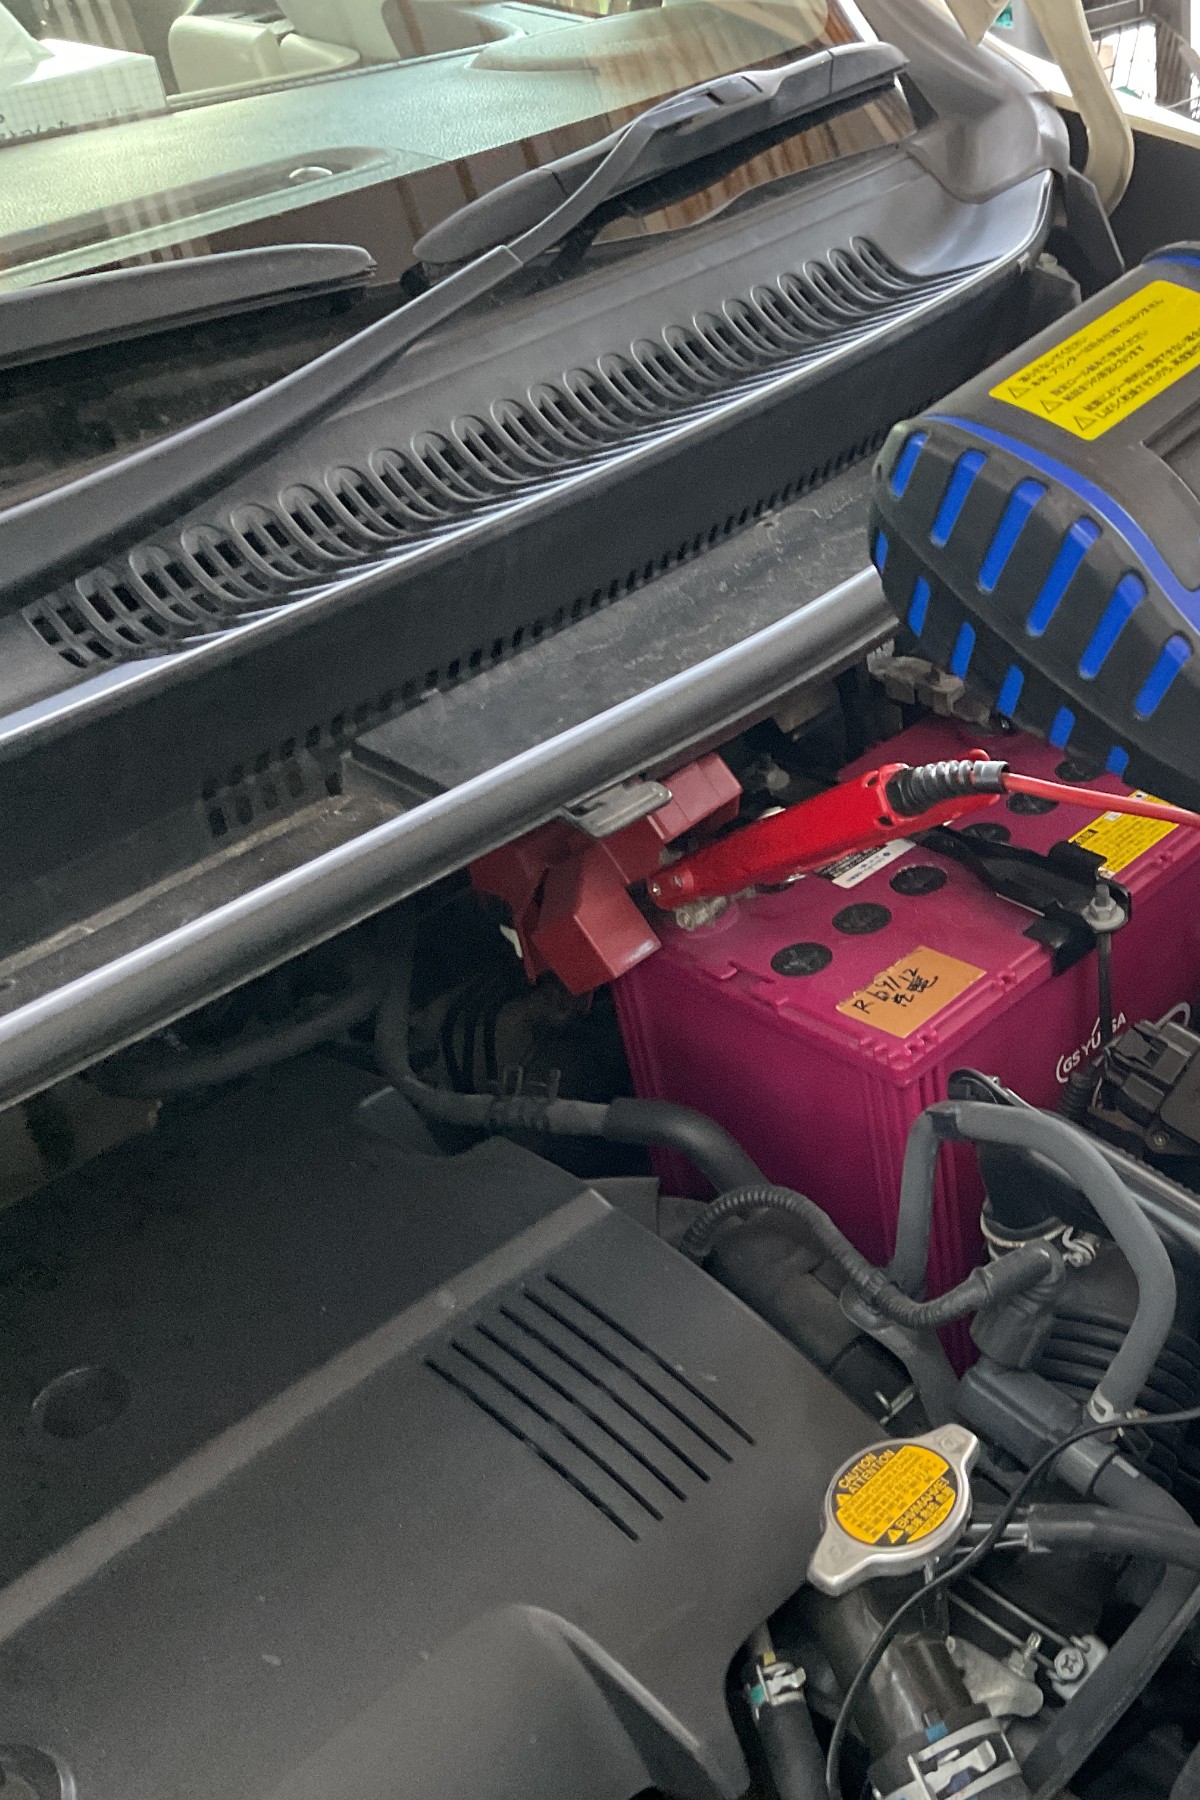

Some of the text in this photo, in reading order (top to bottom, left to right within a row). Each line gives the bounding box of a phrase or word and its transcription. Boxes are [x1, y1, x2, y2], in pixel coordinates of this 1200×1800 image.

[1081, 1011, 1127, 1055] YUSA
[838, 1452, 877, 1489] CAUTION
[848, 1449, 896, 1494] ATTENTION
